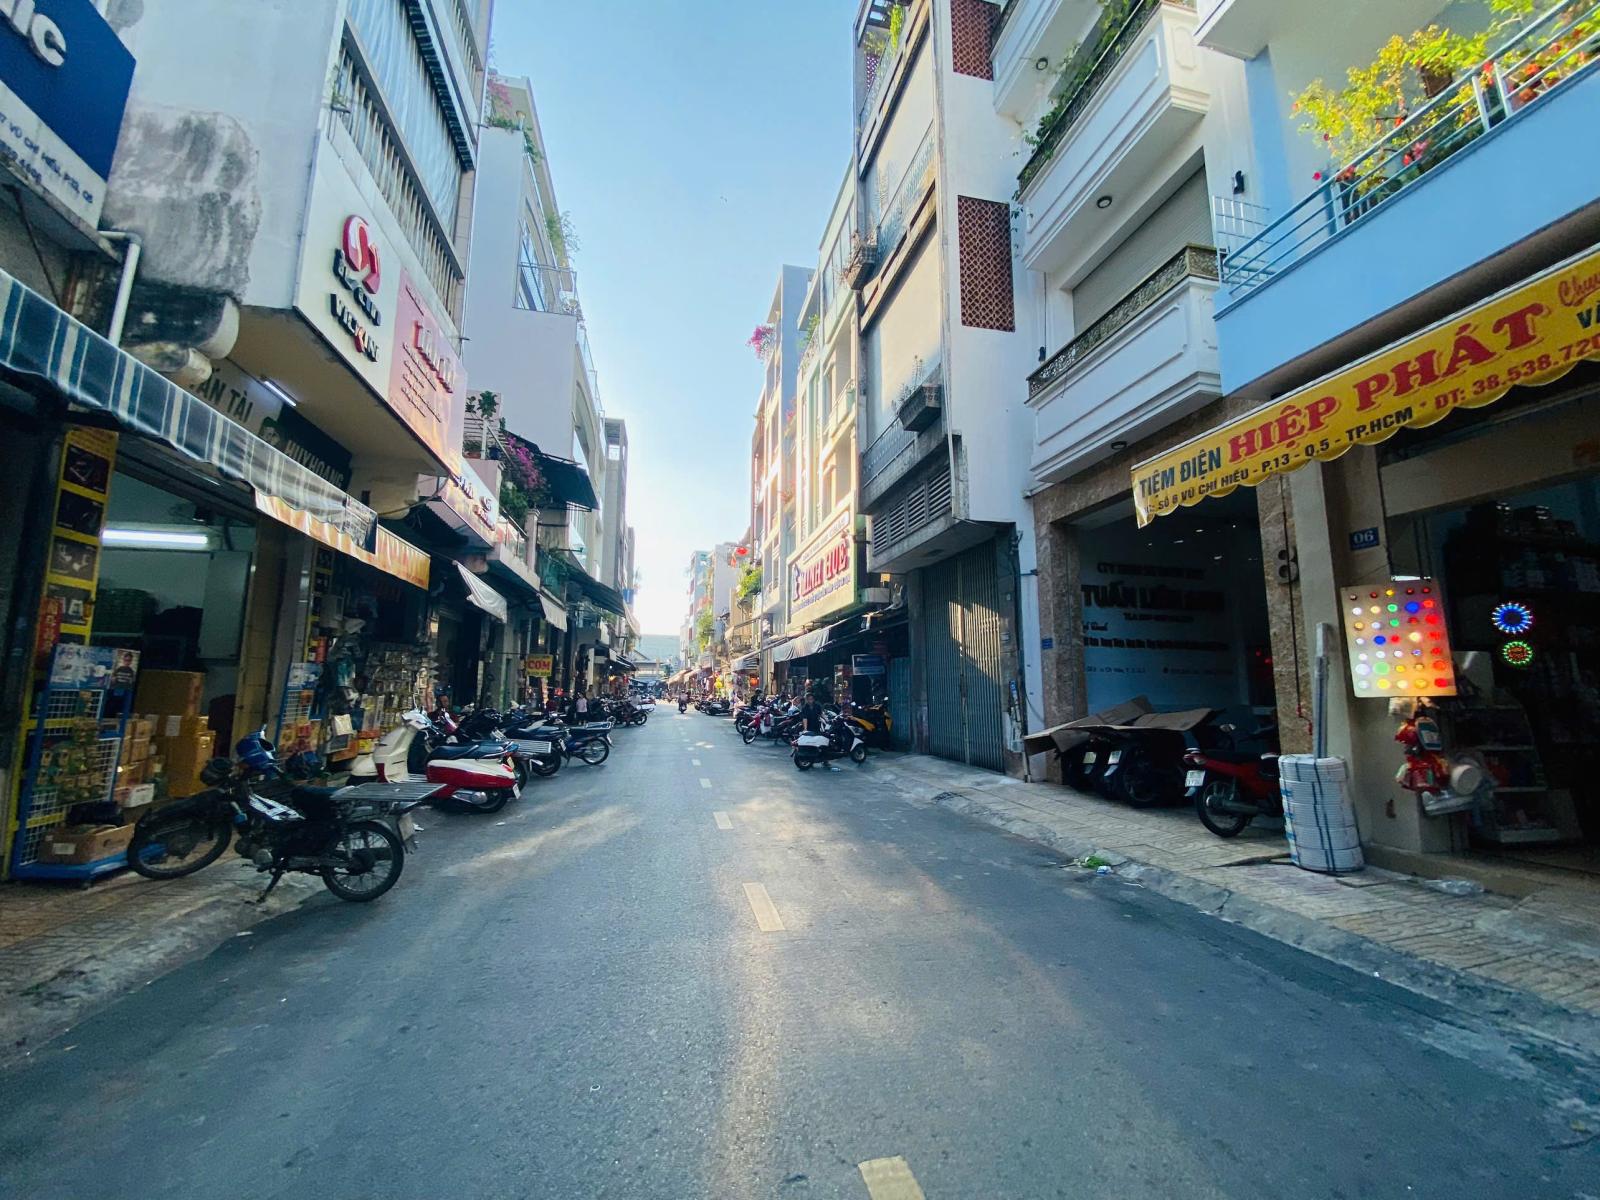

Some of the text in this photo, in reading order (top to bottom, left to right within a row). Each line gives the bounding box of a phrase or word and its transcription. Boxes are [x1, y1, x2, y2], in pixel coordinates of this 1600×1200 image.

[231, 388, 254, 423] TÀI
[1139, 303, 1546, 498] TIỆM ĐIỆN HIỆP PHÁT
[1181, 487, 1195, 501] VŨ
[1199, 480, 1217, 495] CHÍ
[1221, 467, 1249, 487] HIẾU
[1261, 453, 1290, 473] P.13
[1346, 407, 1413, 442] TP.HCM
[1353, 530, 1375, 545] 06
